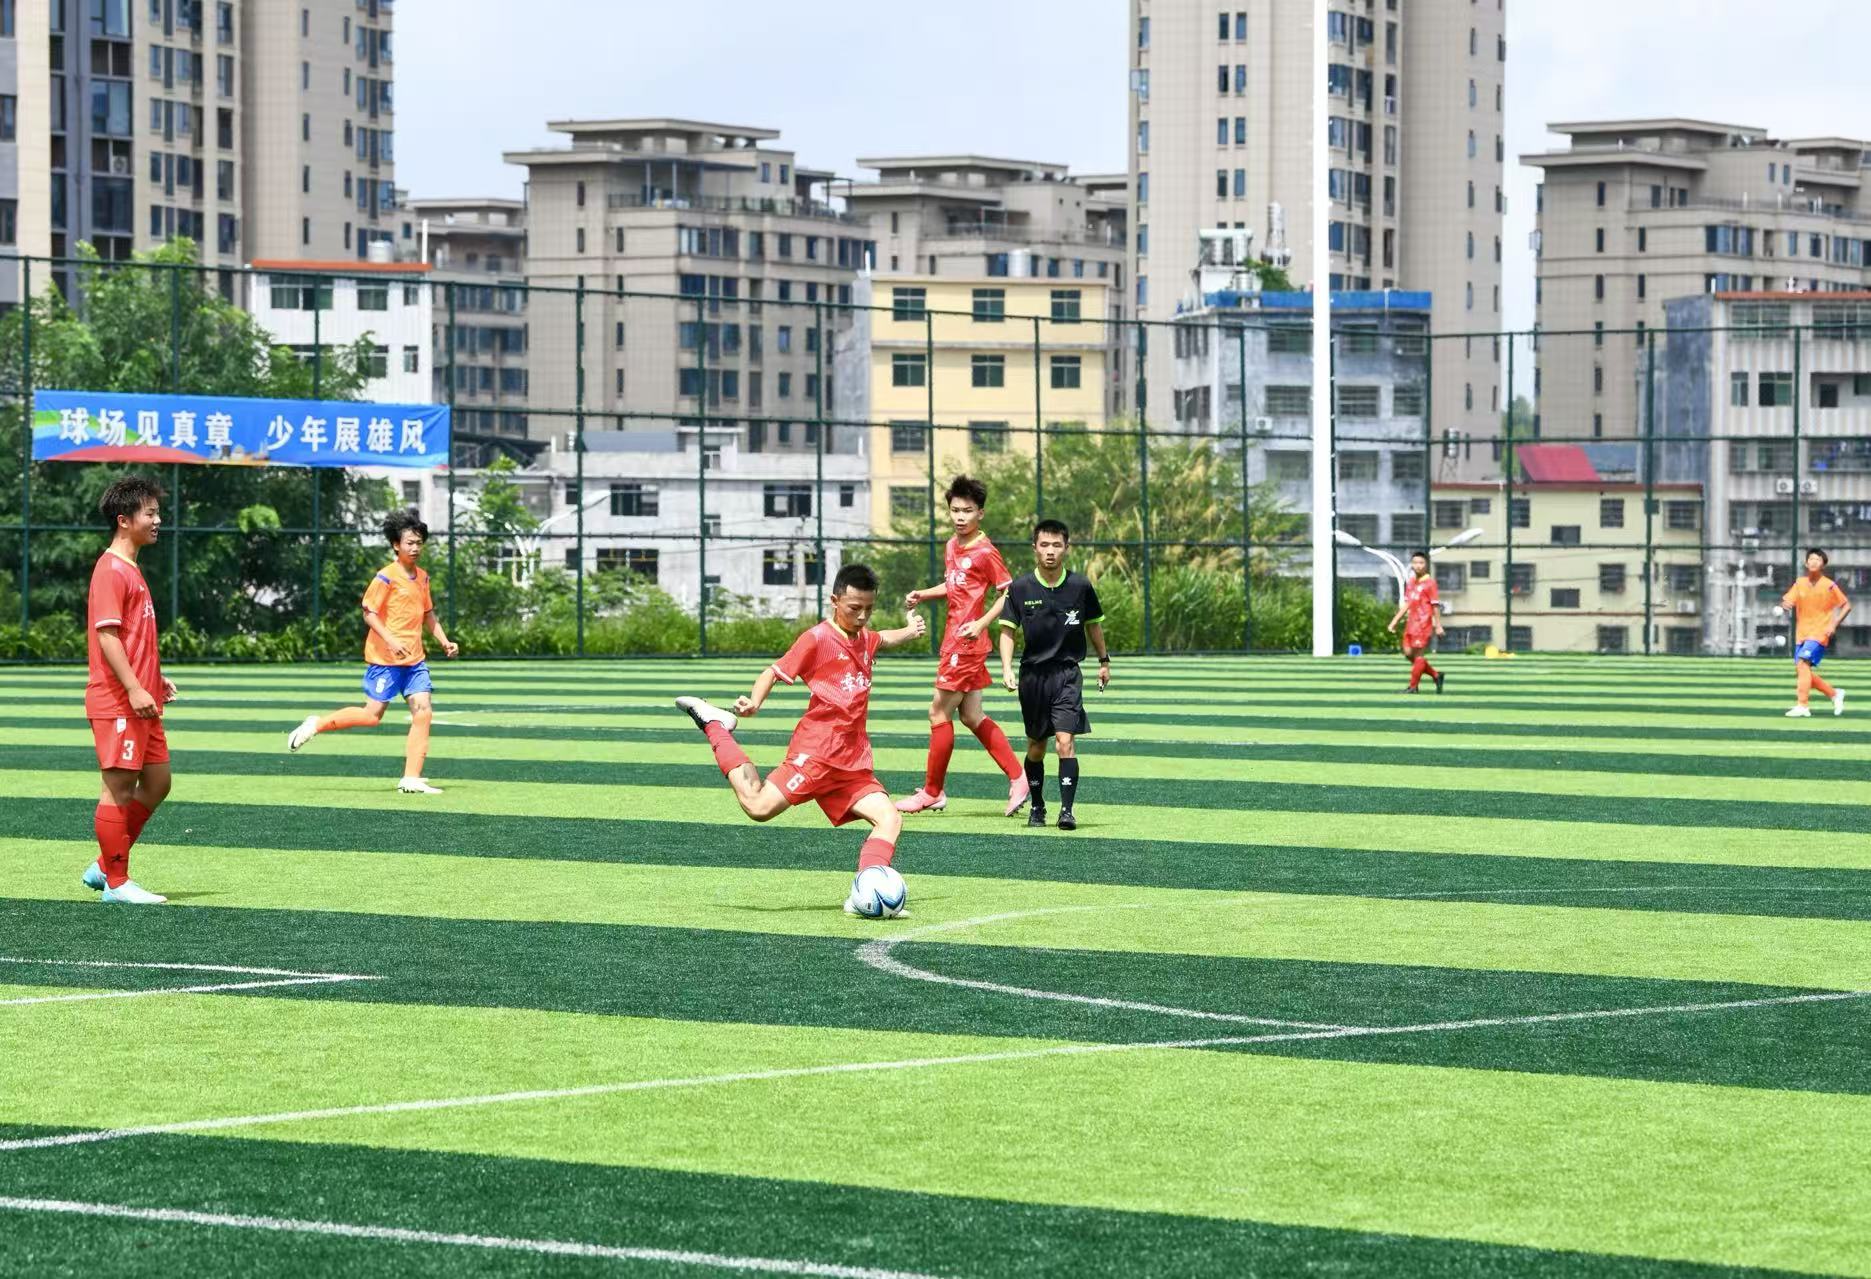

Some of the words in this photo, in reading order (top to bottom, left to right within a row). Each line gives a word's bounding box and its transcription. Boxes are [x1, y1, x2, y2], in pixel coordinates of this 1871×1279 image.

[59, 407, 233, 450] 球场见真章
[267, 415, 427, 454] 少年展雄风
[122, 739, 135, 761] 3
[786, 773, 805, 792] 6
